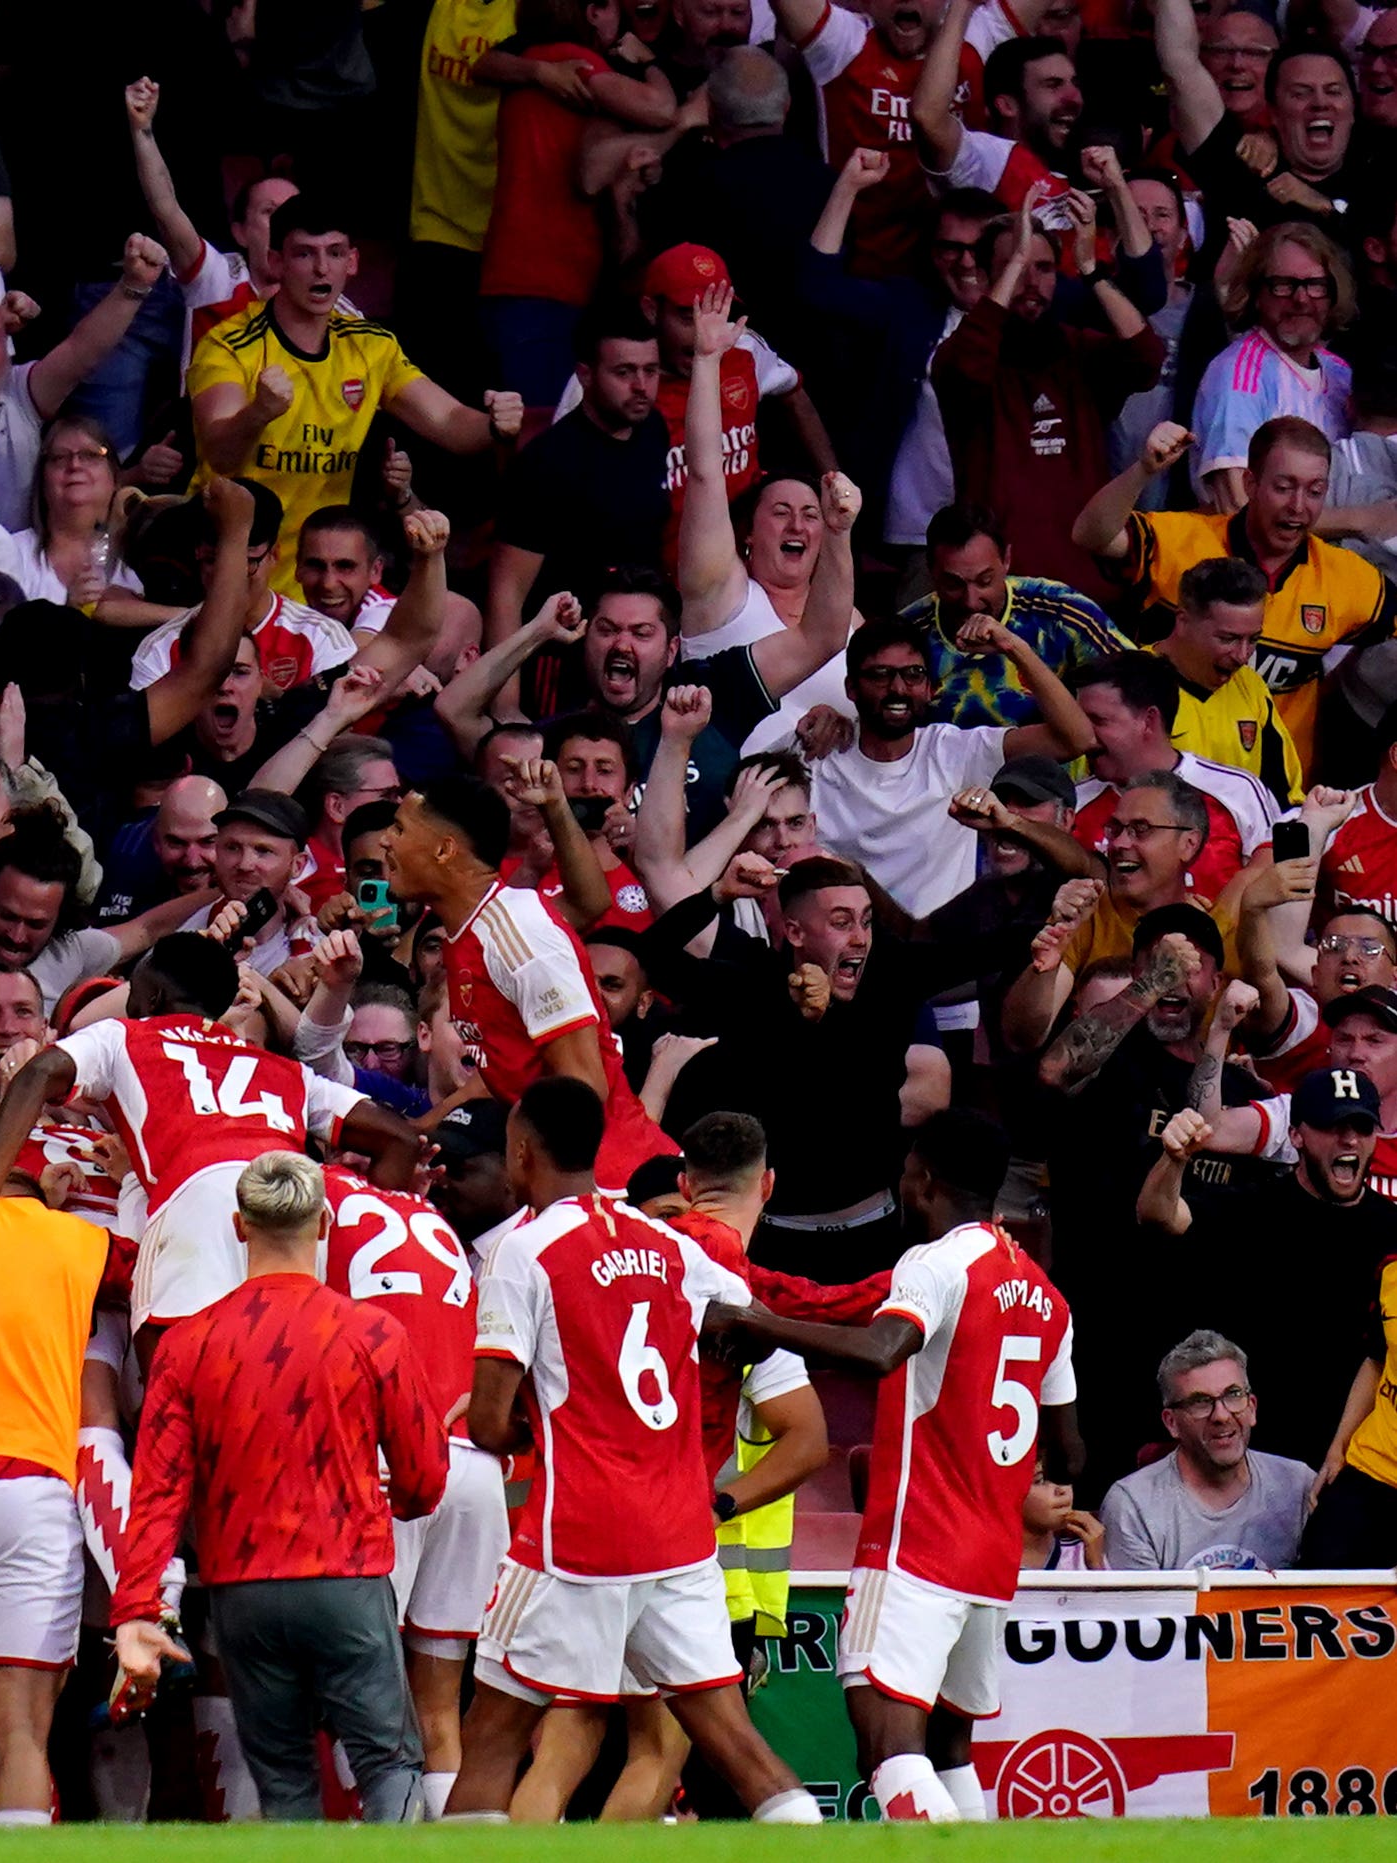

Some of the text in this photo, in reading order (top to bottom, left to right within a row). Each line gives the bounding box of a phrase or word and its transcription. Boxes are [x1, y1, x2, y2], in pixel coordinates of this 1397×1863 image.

[302, 423, 334, 448] Fly
[161, 1041, 296, 1131] 14
[1330, 1070, 1360, 1099] H
[336, 1193, 473, 1308] 29
[591, 1247, 668, 1288] GABRIEL
[616, 1300, 680, 1432] 6
[986, 1334, 1043, 1468] 5
[1005, 1606, 1396, 1665] GOONERS
